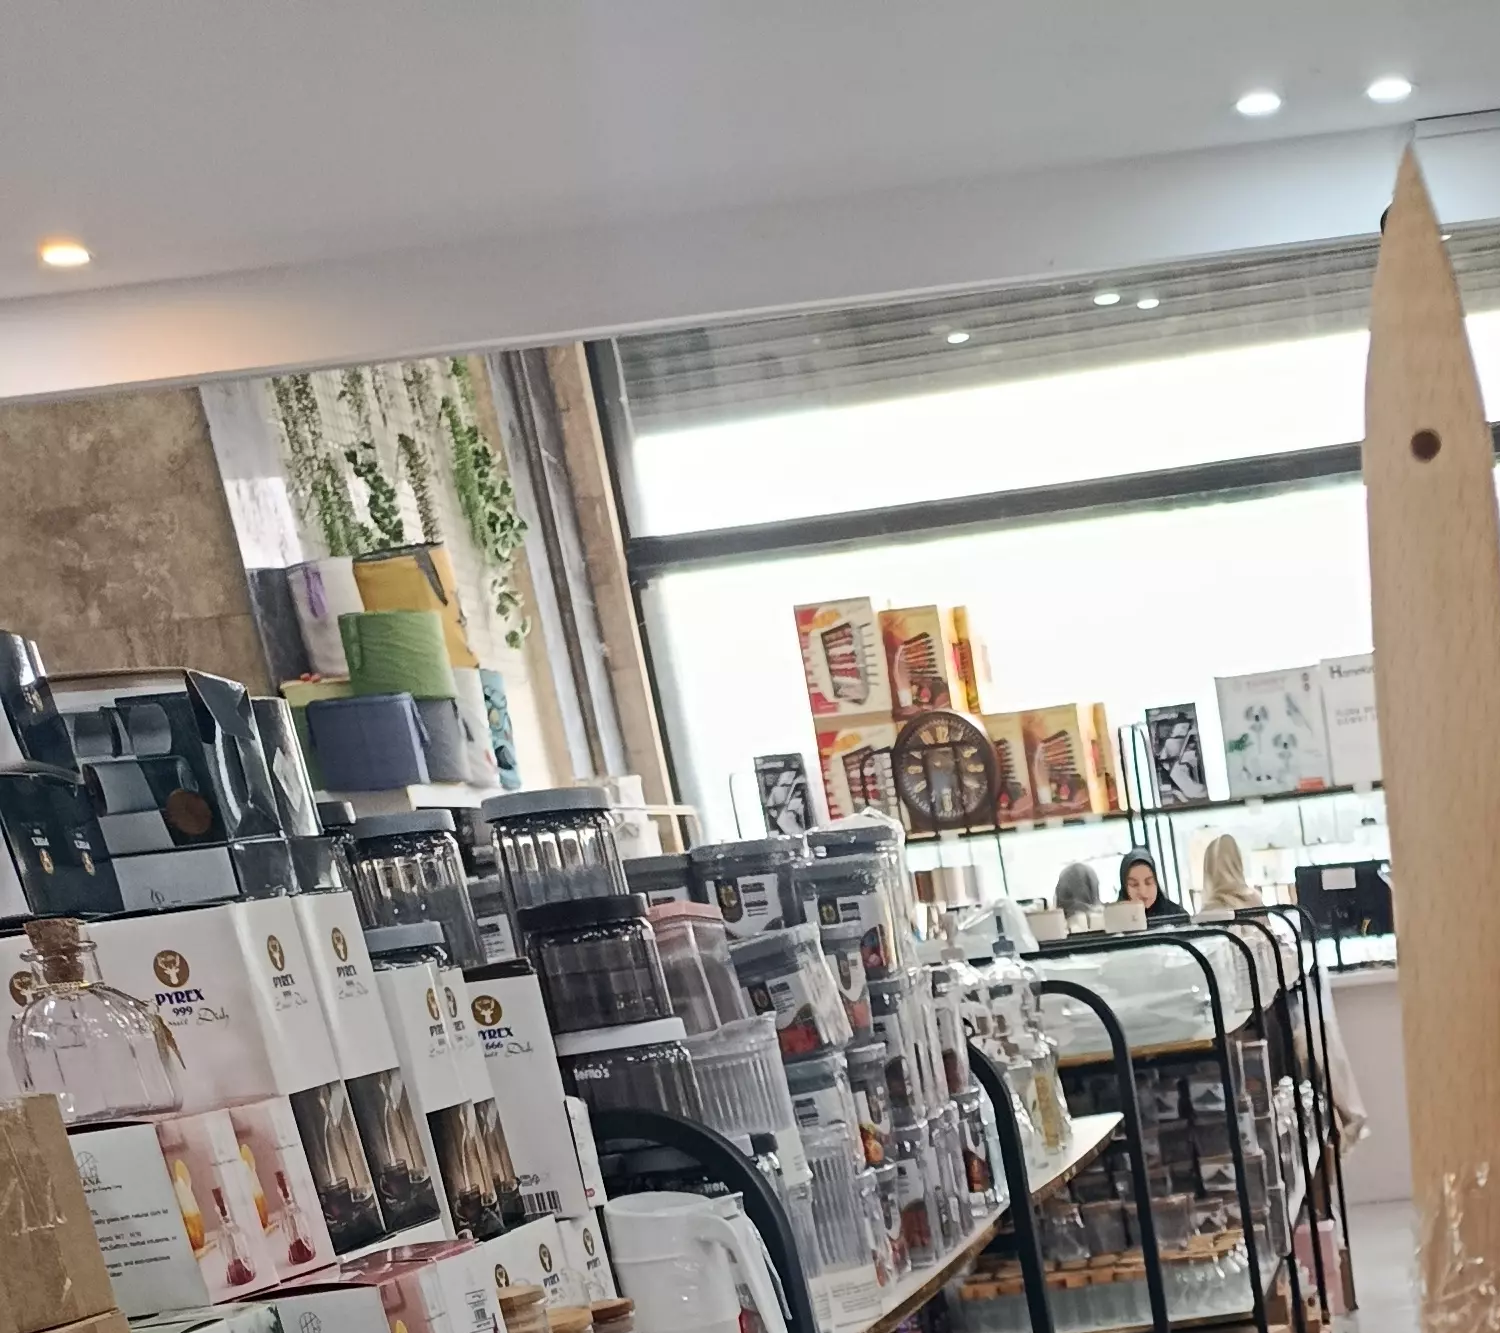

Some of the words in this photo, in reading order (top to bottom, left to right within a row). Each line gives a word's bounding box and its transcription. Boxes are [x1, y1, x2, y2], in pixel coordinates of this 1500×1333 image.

[155, 988, 205, 1006] PYREX
[172, 1006, 193, 1017] 999
[478, 1026, 514, 1040] YREX
